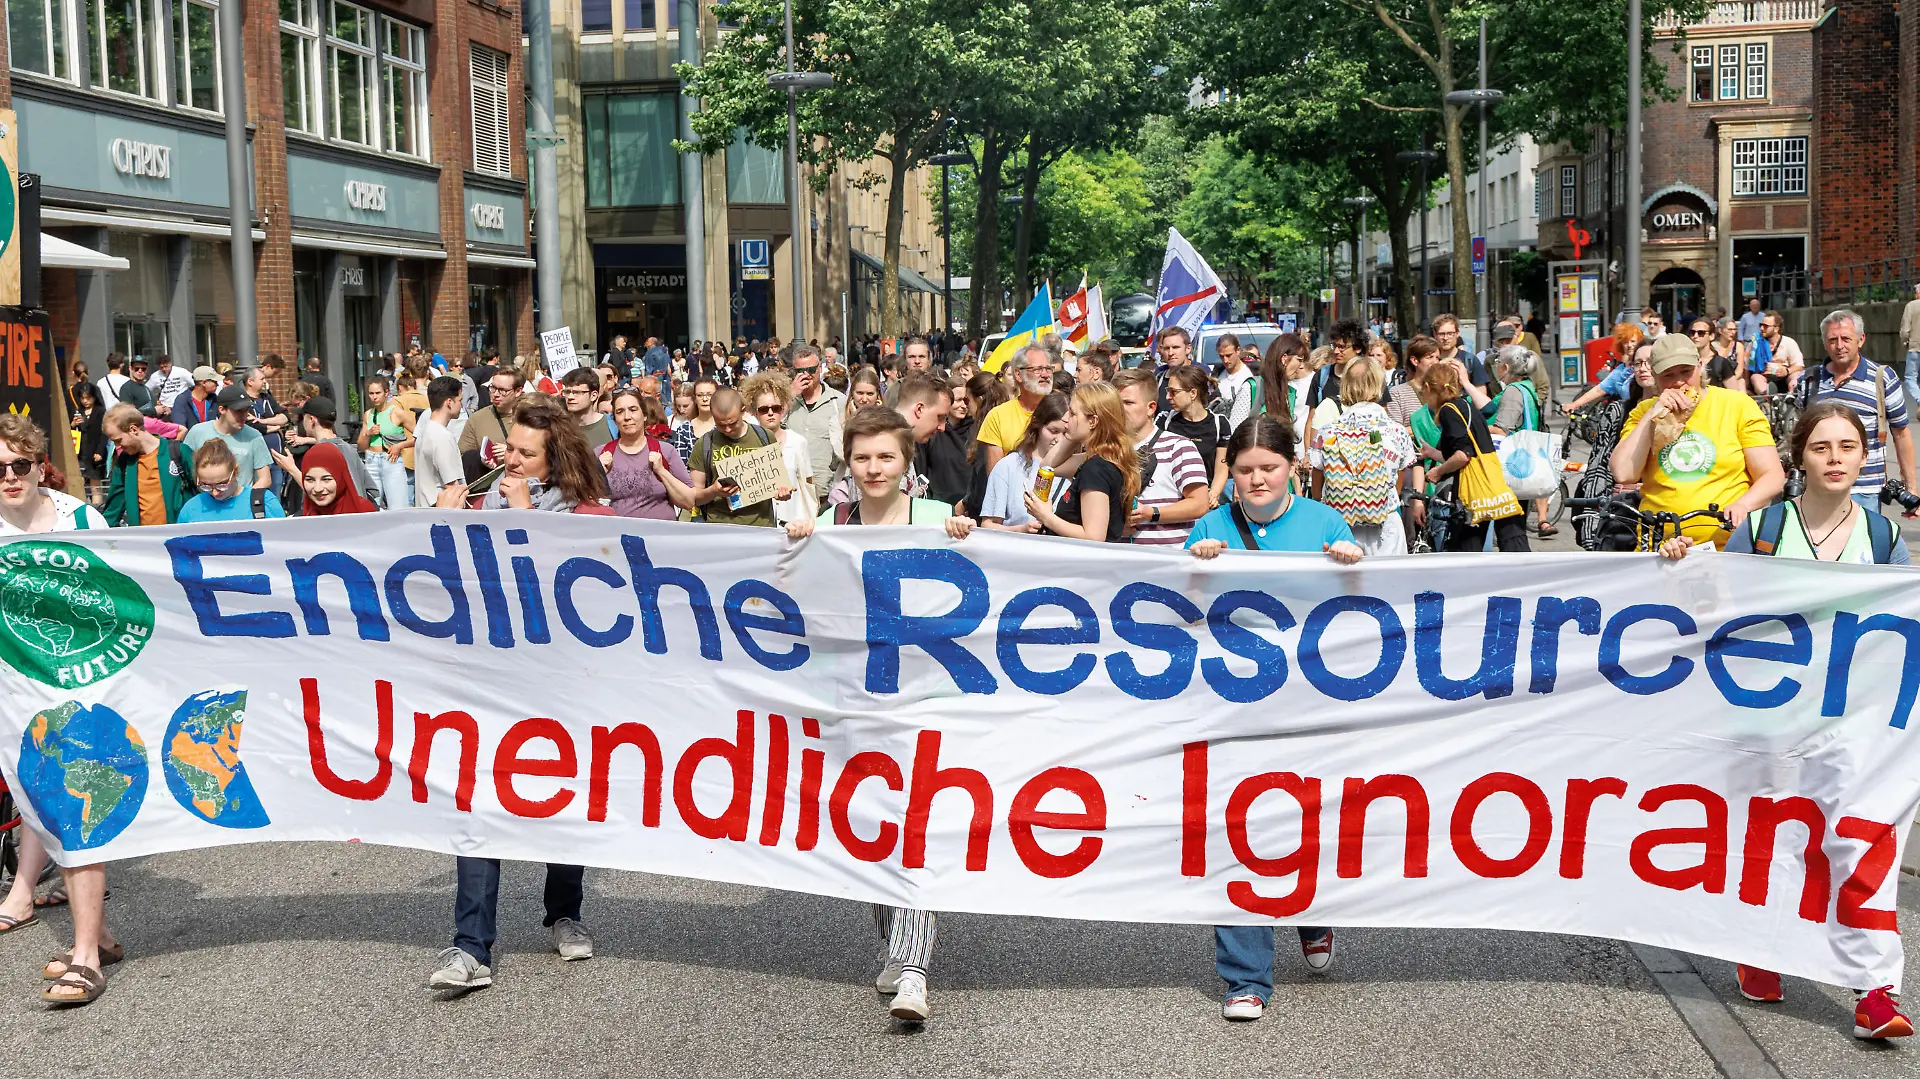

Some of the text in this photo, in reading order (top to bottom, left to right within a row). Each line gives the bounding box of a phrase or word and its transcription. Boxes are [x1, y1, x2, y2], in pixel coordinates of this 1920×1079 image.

[112, 138, 171, 178] CHRIST
[347, 180, 386, 211] CHRIST
[474, 203, 504, 229] CHRIST
[1653, 212, 1703, 226] OMEN
[746, 242, 764, 263] U
[616, 275, 685, 287] KARSTADT
[543, 332, 570, 346] PEOPLE
[556, 346, 568, 355] NOT
[551, 356, 577, 372] PROFIT
[719, 447, 778, 477] Verkehr ist
[733, 464, 780, 492] fentlich
[1471, 491, 1515, 510] CLIMATE
[1473, 503, 1517, 520] JUSTICE
[31, 548, 89, 574] FOR
[163, 523, 1920, 730] Endliche Ressourcen
[57, 622, 148, 686] FUTURE
[299, 677, 1898, 936] Unendliche Ignoranz
